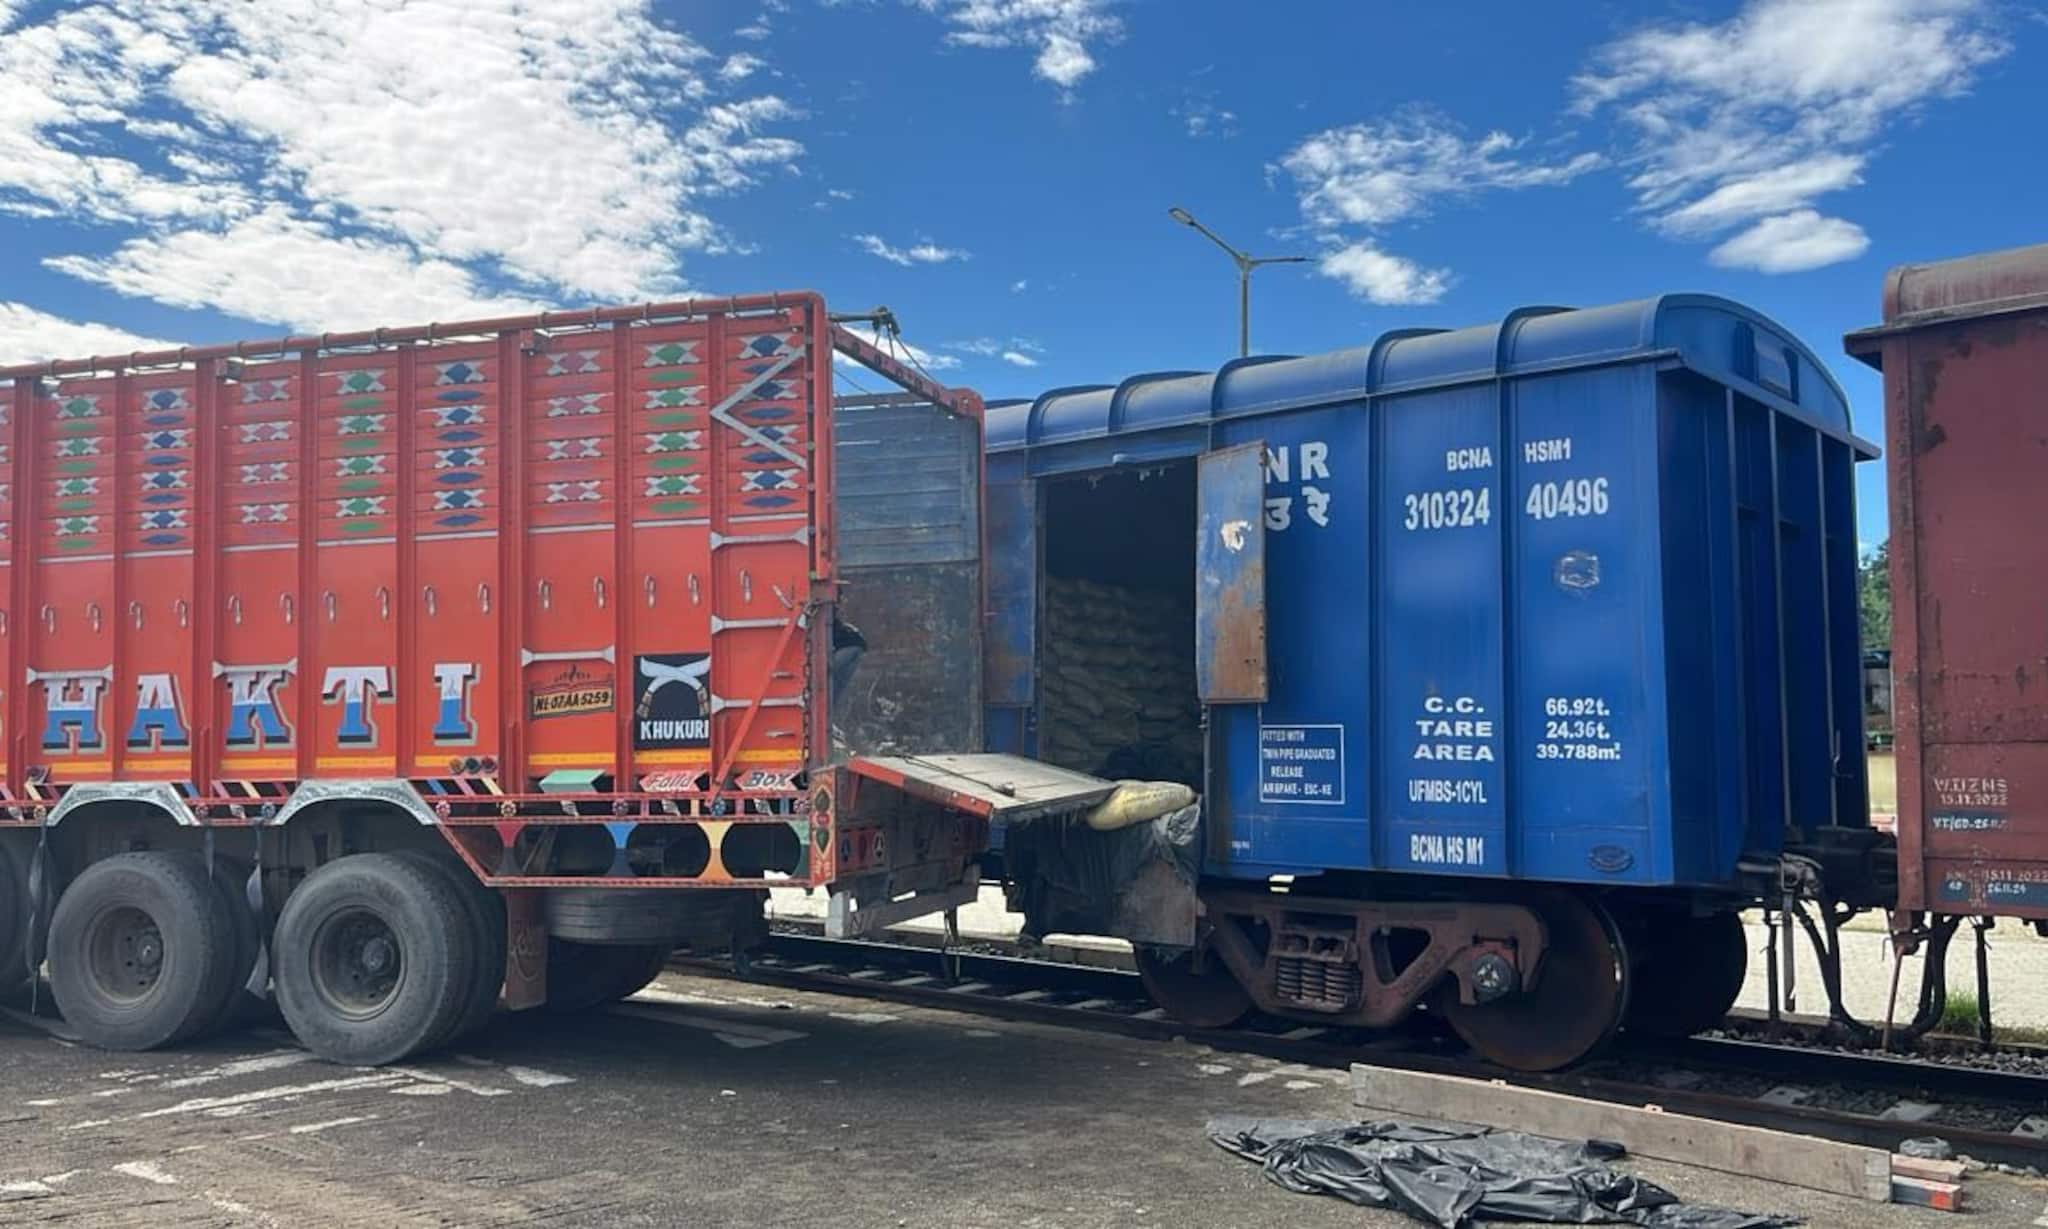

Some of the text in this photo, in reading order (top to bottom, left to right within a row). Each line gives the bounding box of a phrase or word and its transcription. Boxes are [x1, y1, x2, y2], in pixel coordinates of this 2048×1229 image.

[1447, 437, 1571, 471] BCNA HSM1
[1405, 477, 1608, 530] 310324 40496
[0, 663, 480, 755] HAKTI
[1424, 697, 1484, 712] C.C.
[641, 719, 709, 740] KHUKURI
[1416, 720, 1493, 737] TARE
[1295, 748, 1336, 761] GRADUATED
[1413, 744, 1494, 761] AREA
[1270, 766, 1304, 778] RELEASE
[1409, 779, 1487, 804] UFMBS-1CYL
[1411, 834, 1484, 866] BCNA HS M1
